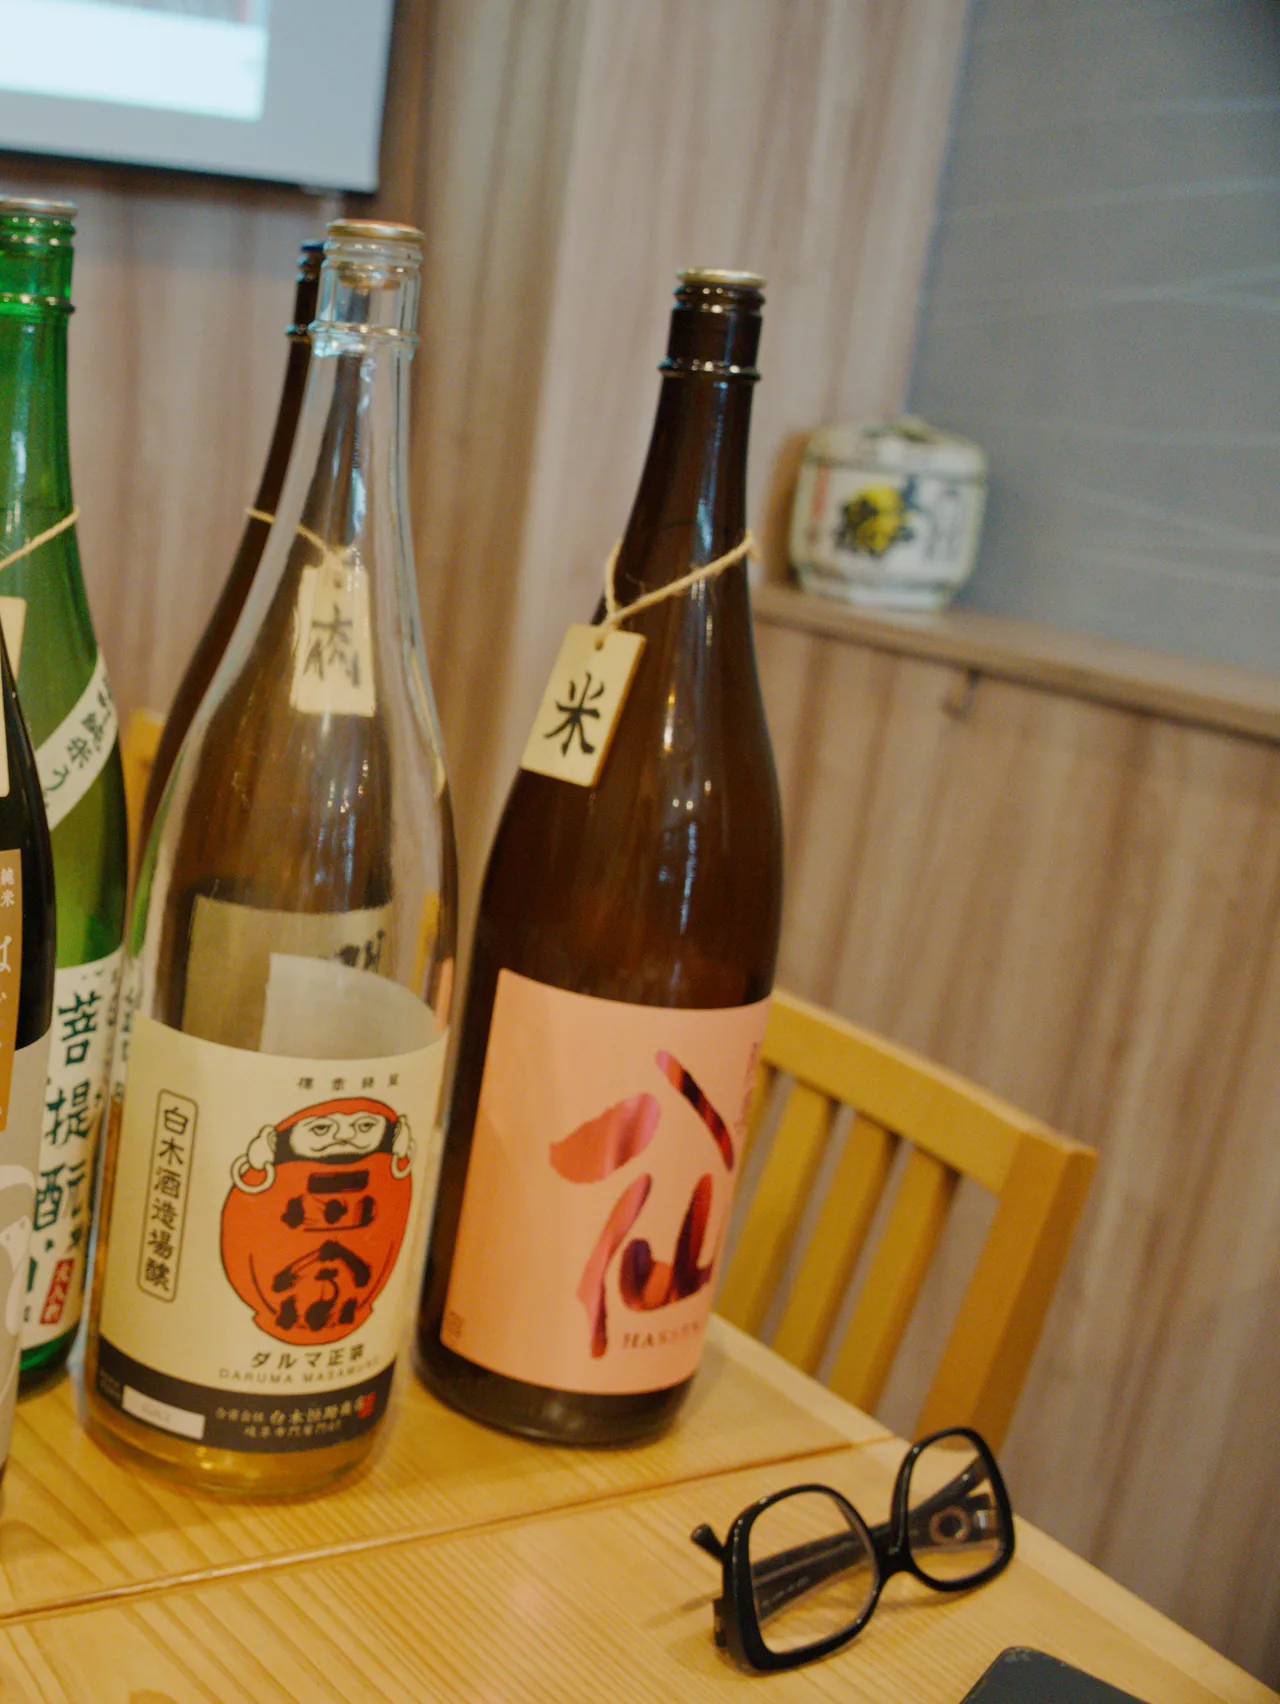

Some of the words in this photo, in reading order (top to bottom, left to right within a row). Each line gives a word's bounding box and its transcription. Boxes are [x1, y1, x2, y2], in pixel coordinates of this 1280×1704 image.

[543, 672, 606, 758] 米
[250, 1342, 365, 1369] ダルマ正宗
[217, 1366, 294, 1384] DARUMA
